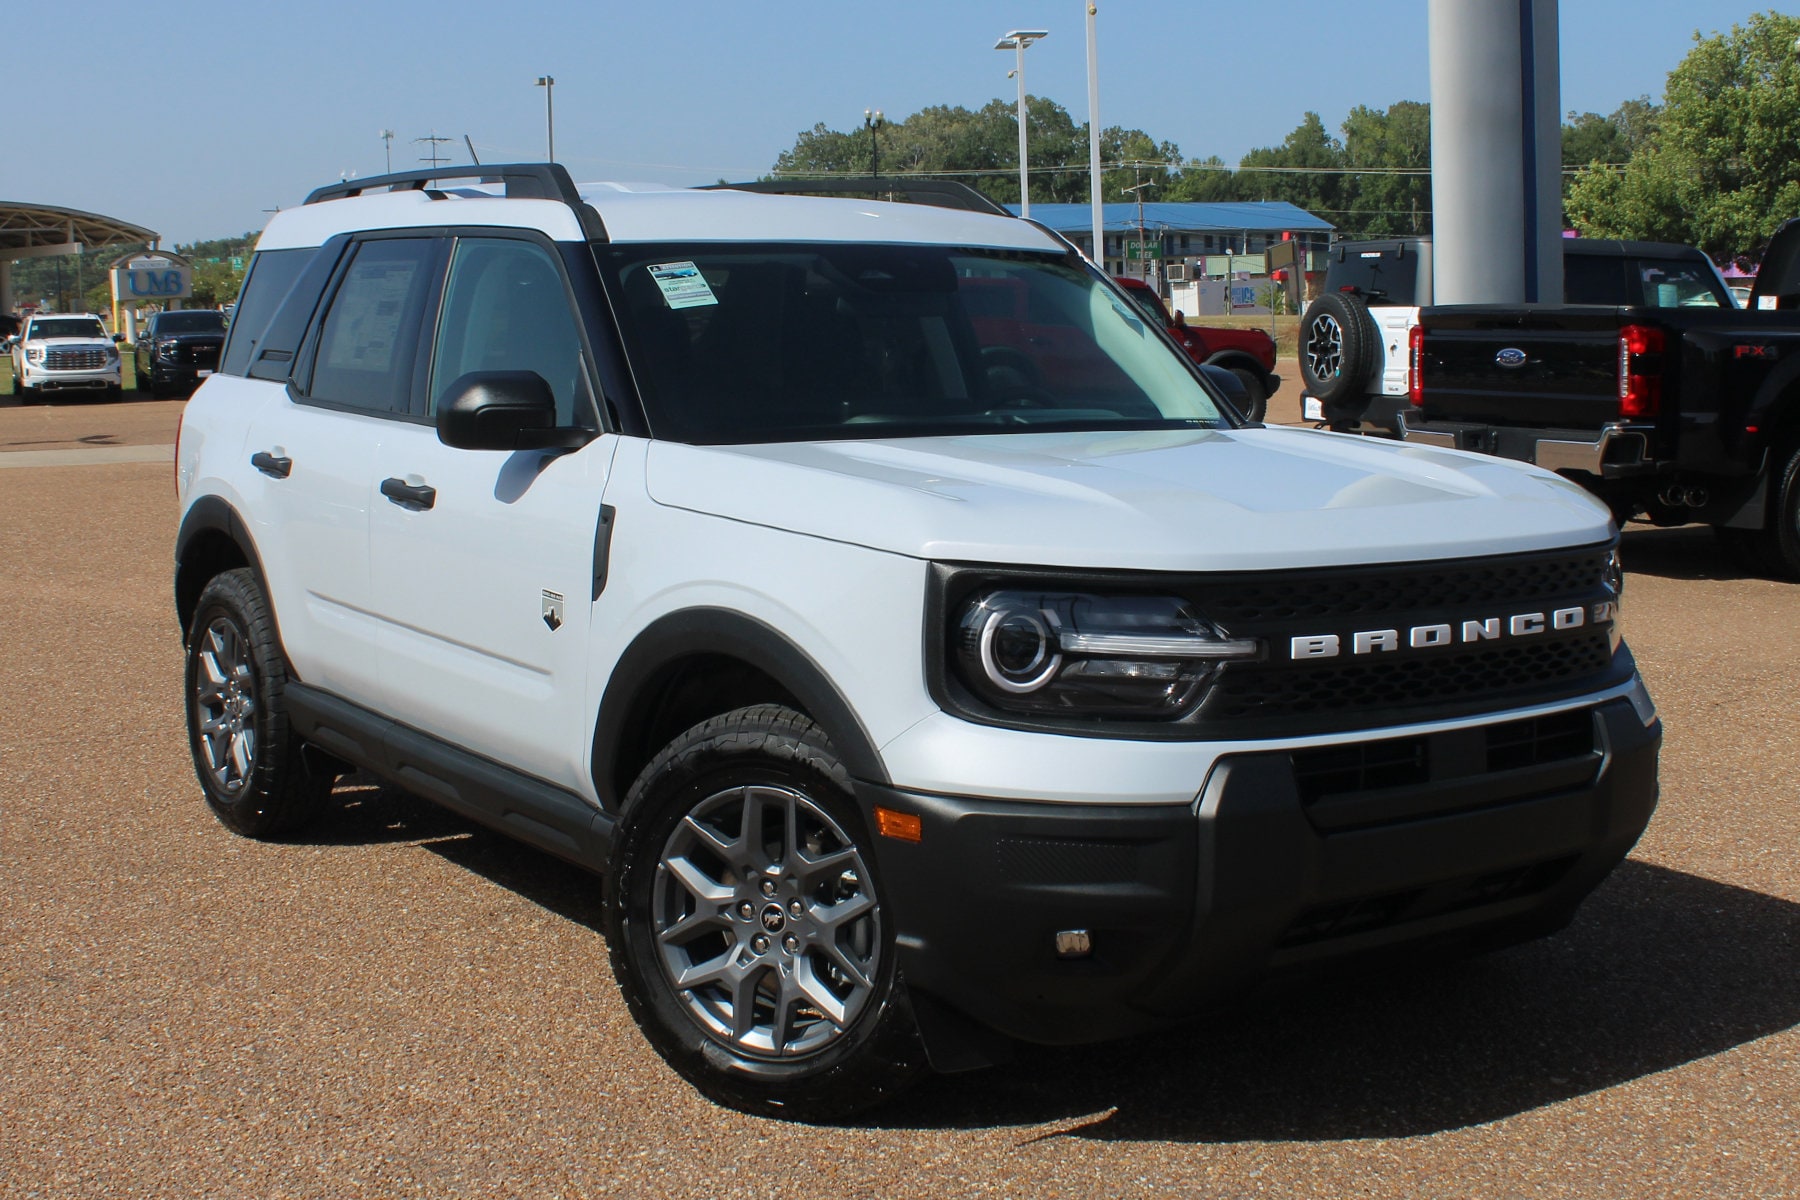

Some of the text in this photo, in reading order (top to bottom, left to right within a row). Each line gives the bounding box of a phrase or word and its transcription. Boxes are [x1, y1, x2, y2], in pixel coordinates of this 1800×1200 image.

[1130, 241, 1158, 249] DOLAR
[1135, 251, 1153, 259] TEE
[1290, 606, 1584, 660] BRONCO
